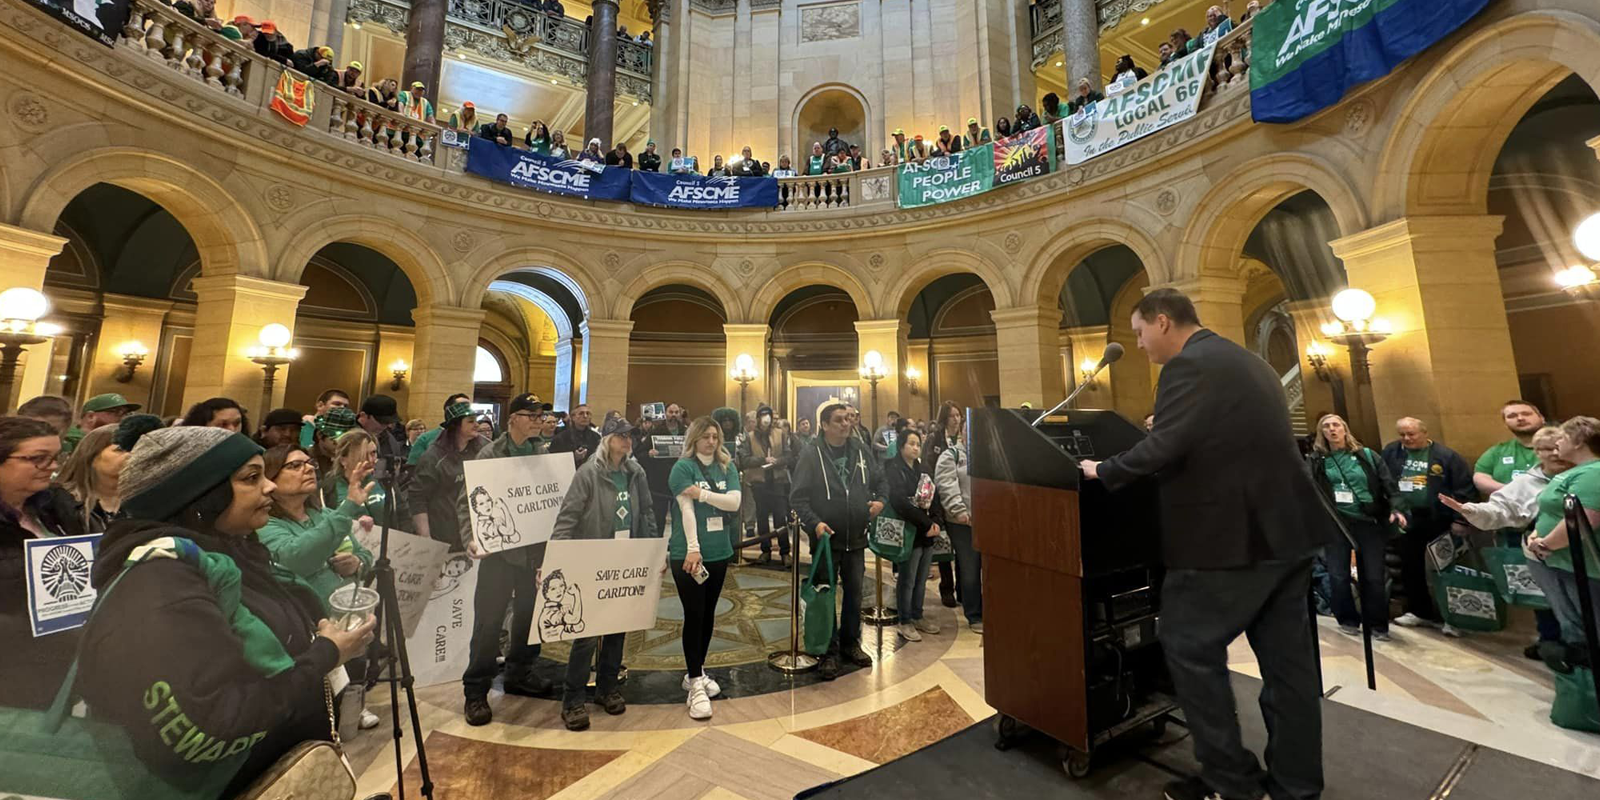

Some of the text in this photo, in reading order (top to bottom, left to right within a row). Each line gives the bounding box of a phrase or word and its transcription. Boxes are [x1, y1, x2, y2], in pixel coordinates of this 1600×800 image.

[1275, 52, 1294, 68] We
[1114, 79, 1199, 130] LOCAL 66
[1083, 144, 1097, 158] In
[1098, 137, 1115, 152] the
[1117, 121, 1154, 146] Public
[520, 155, 541, 165] Council
[510, 172, 589, 192] We Make Minnesota Happen
[511, 161, 591, 188] AFSCME
[913, 166, 972, 189] PEOPLE
[1000, 165, 1042, 183] Council 5
[668, 185, 740, 199] AFSCME
[922, 180, 981, 202] POWER
[507, 482, 560, 498] SAVE CARE
[595, 567, 649, 582] SAVE CARE
[451, 598, 463, 629] SAVE
